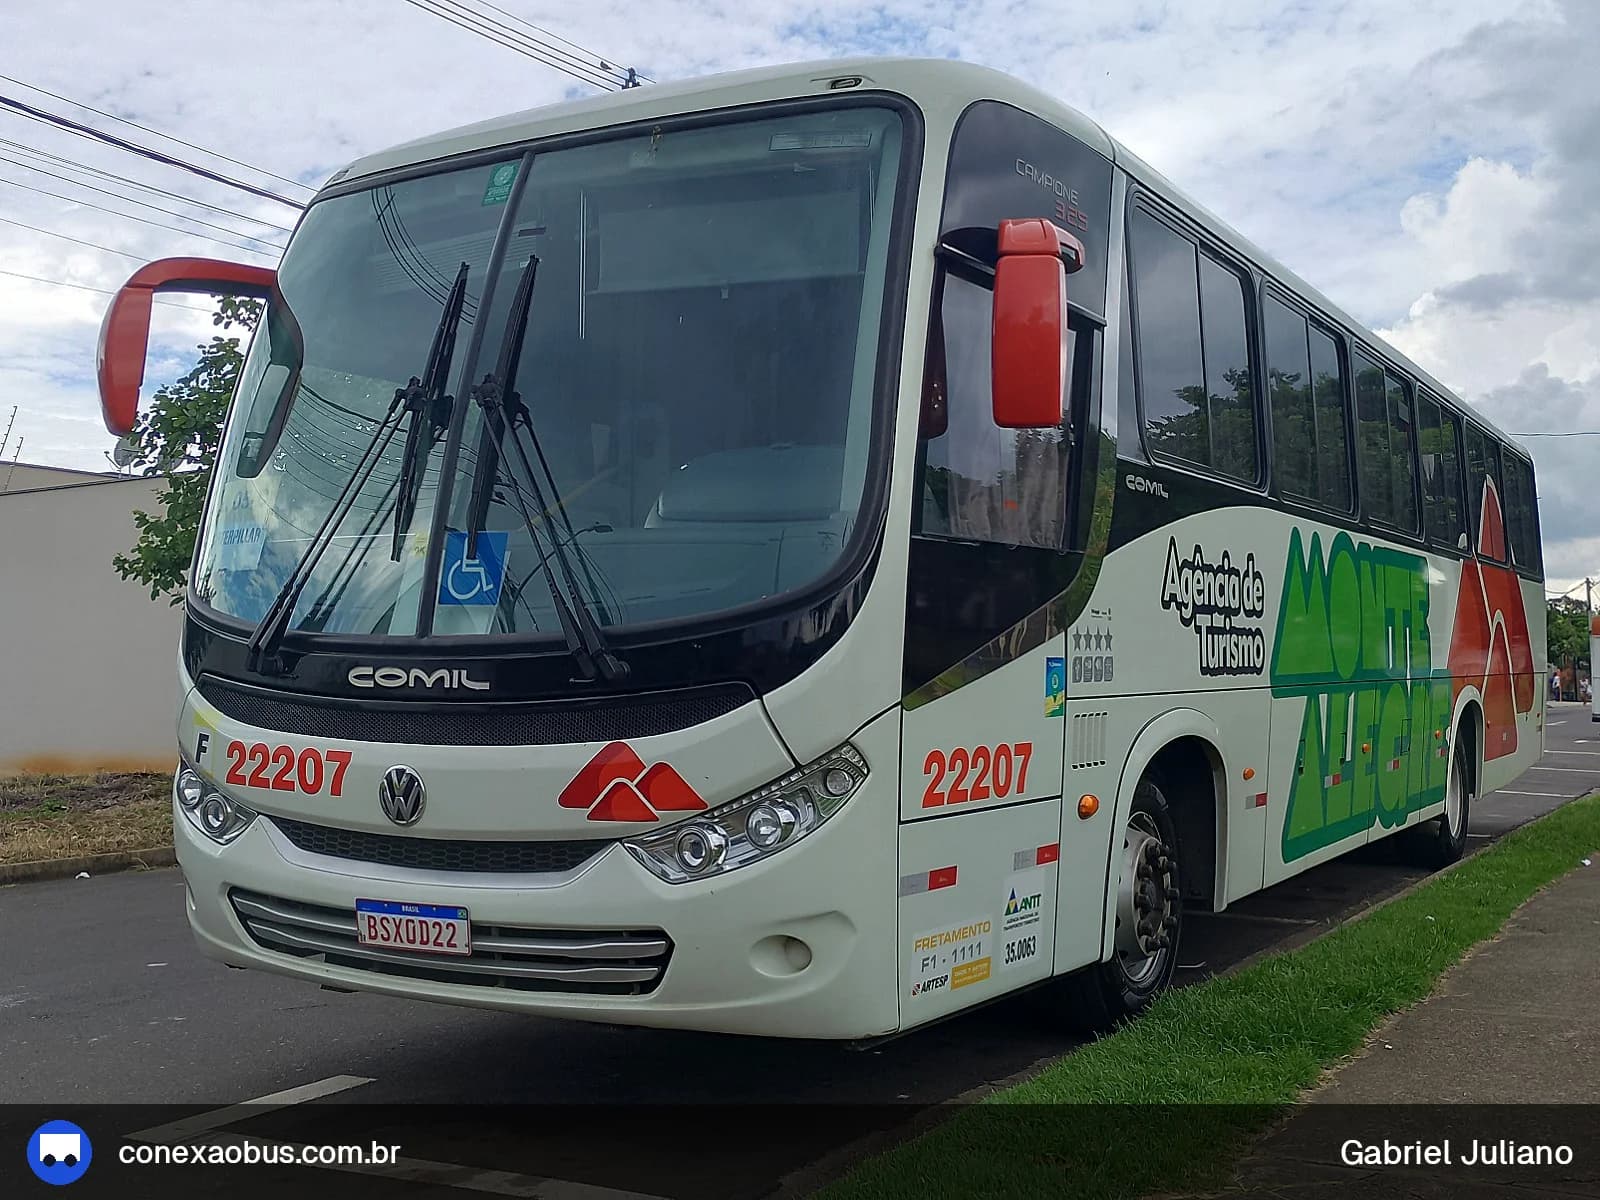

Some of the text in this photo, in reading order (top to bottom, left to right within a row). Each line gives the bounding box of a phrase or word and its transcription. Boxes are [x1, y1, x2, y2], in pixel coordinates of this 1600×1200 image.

[1015, 158, 1079, 206] CAMPIONE
[1125, 474, 1169, 499] COMIL
[1162, 535, 1265, 627] Agência de
[1271, 527, 1431, 684] MONTE
[1194, 614, 1266, 676] Turismo
[348, 666, 490, 690] COMIL
[195, 733, 210, 764] F
[225, 740, 353, 797] 22207
[921, 741, 1033, 809] 22207
[401, 904, 420, 914] BRASIL
[1019, 893, 1042, 913] ANTT
[914, 920, 991, 953] FRETAMENTO
[1004, 935, 1037, 965] 35.0063
[921, 954, 937, 973] F1
[951, 940, 982, 963] 1111
[920, 974, 949, 994] ARTESP
